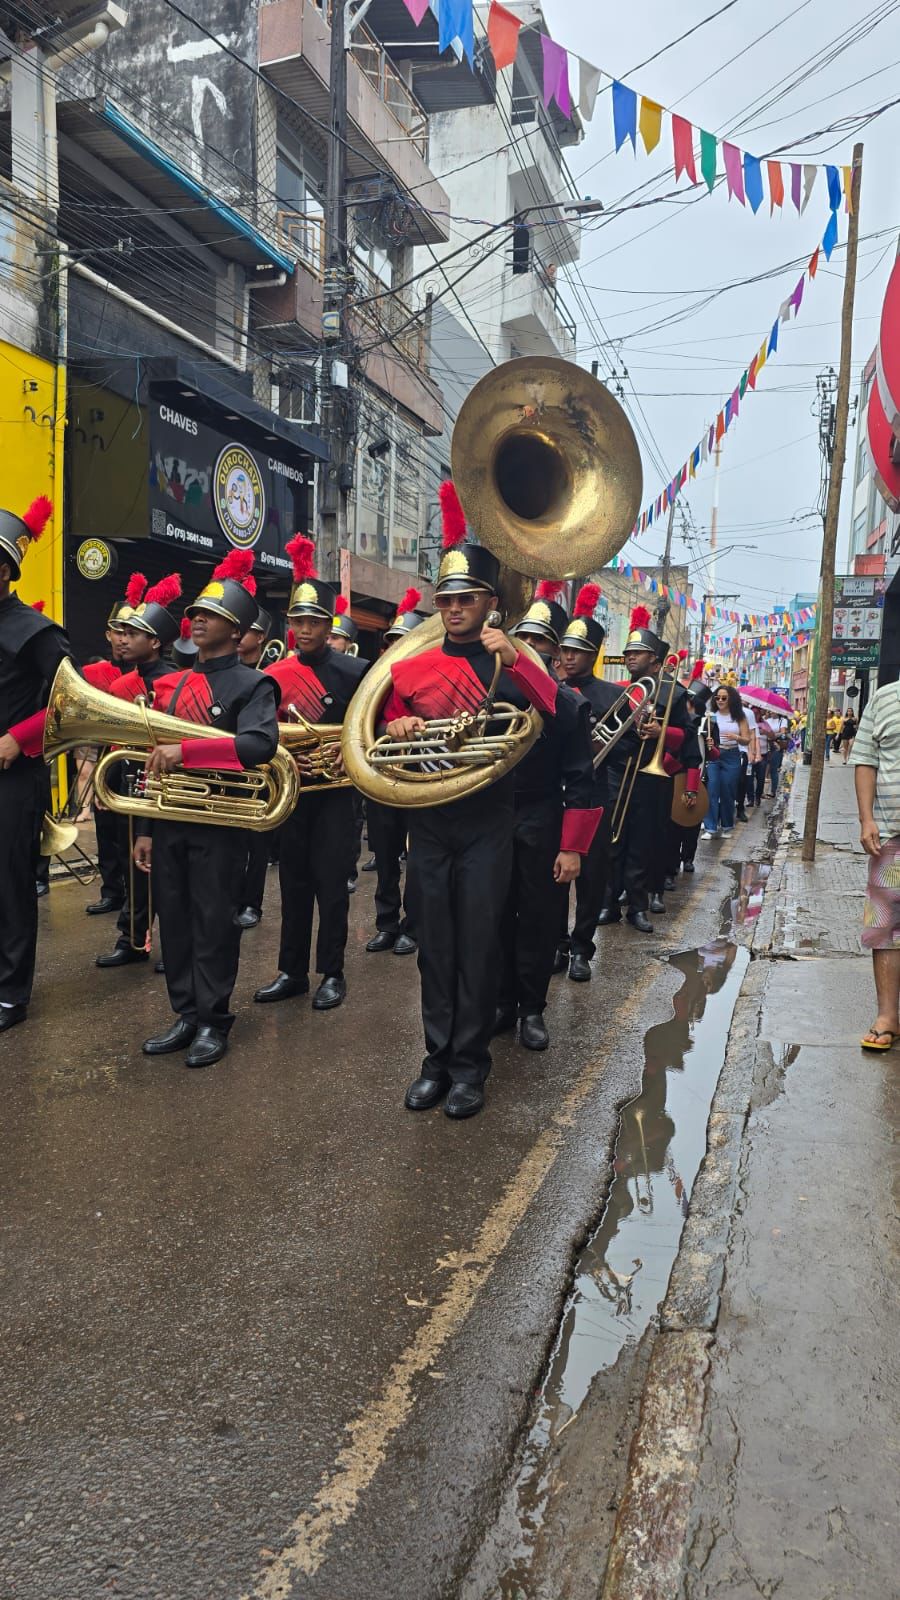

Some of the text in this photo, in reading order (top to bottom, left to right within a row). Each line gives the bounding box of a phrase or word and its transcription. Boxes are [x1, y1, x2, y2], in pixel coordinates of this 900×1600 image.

[159, 404, 199, 436] CHAVES
[220, 453, 260, 496] OUROCHAVE
[267, 457, 304, 484] CARIMBOS
[174, 527, 186, 542] (75)
